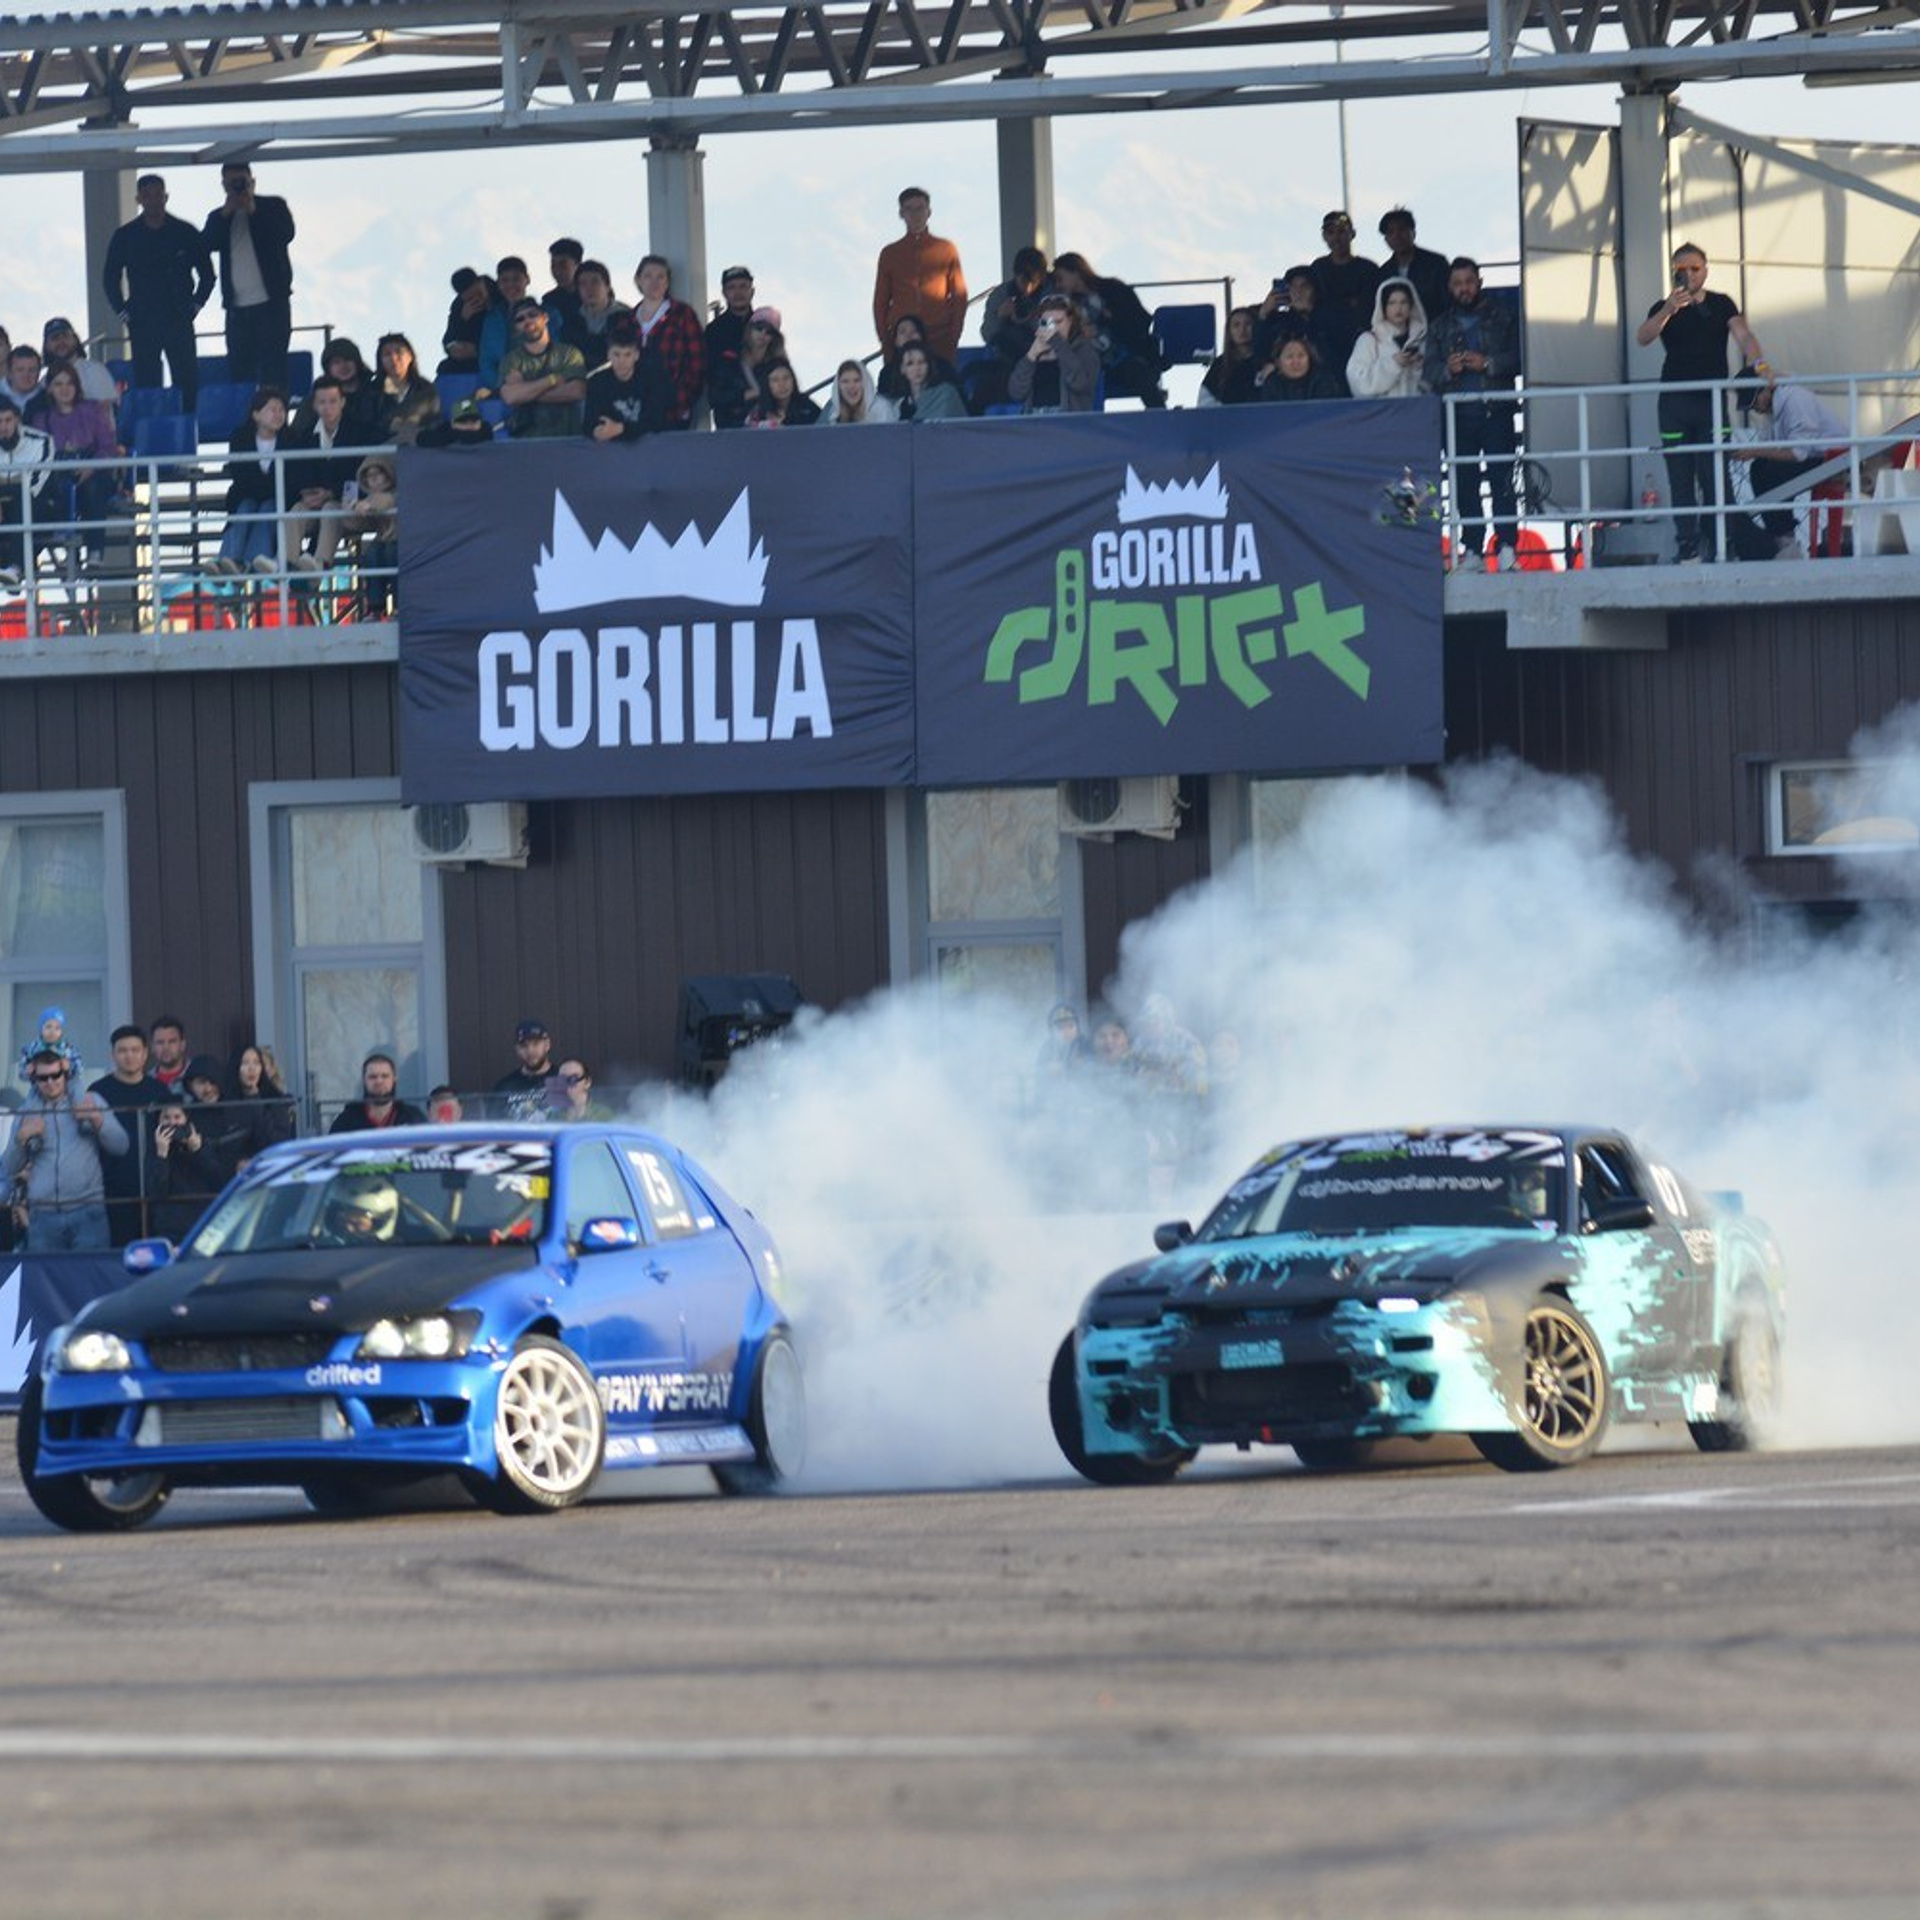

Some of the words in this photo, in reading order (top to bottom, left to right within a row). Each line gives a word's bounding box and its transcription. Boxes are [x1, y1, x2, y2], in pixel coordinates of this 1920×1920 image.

[1092, 522, 1262, 590] GORILLA
[478, 618, 833, 752] GORILLA
[626, 1151, 675, 1207] 75
[305, 1363, 381, 1387] drifted
